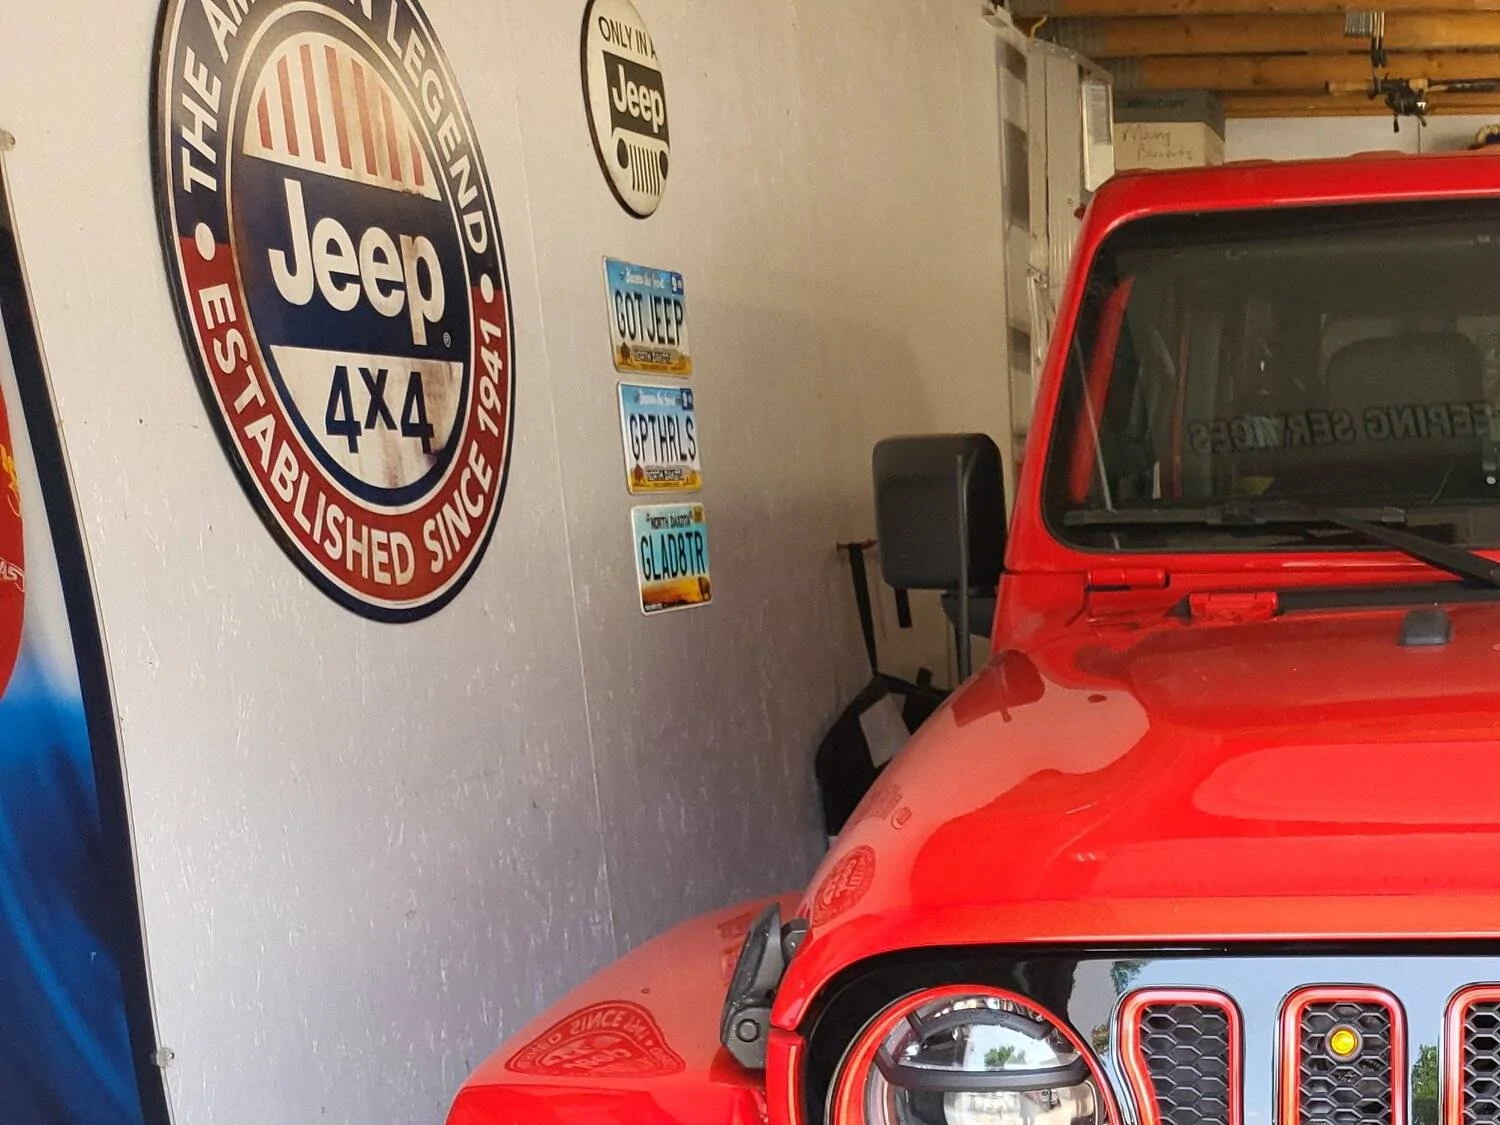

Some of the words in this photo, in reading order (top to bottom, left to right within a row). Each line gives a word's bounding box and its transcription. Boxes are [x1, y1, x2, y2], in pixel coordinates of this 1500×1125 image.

[598, 16, 632, 50] ONLY
[635, 29, 648, 57] IN
[181, 46, 222, 194] THE
[385, 0, 489, 254] LEGEND
[612, 63, 665, 134] Jeep
[268, 178, 445, 346] Jeep
[614, 290, 644, 341] GOT
[646, 292, 684, 346] JEEP
[198, 283, 416, 586] ESTABLISHED
[422, 440, 493, 574] SINCE
[477, 318, 503, 437] 1941
[629, 413, 697, 462] GPTHRLS
[640, 531, 706, 581] GLAD8TR
